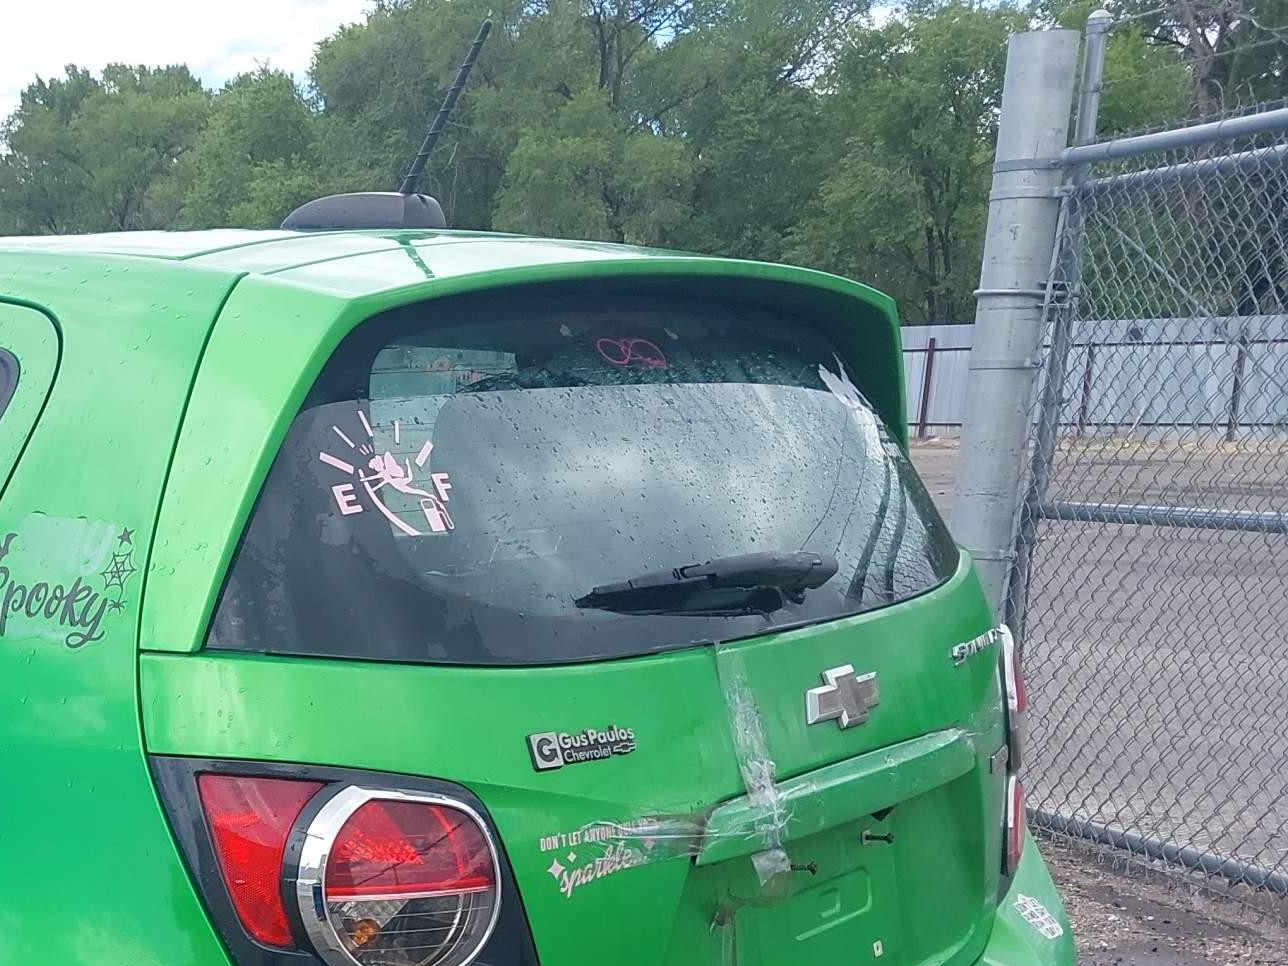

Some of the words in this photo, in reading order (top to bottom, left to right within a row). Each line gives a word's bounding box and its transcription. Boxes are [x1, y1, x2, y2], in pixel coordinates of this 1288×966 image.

[563, 744, 613, 763] Chevrolet
[540, 833, 568, 852] DON'T
[568, 830, 582, 847] LET
